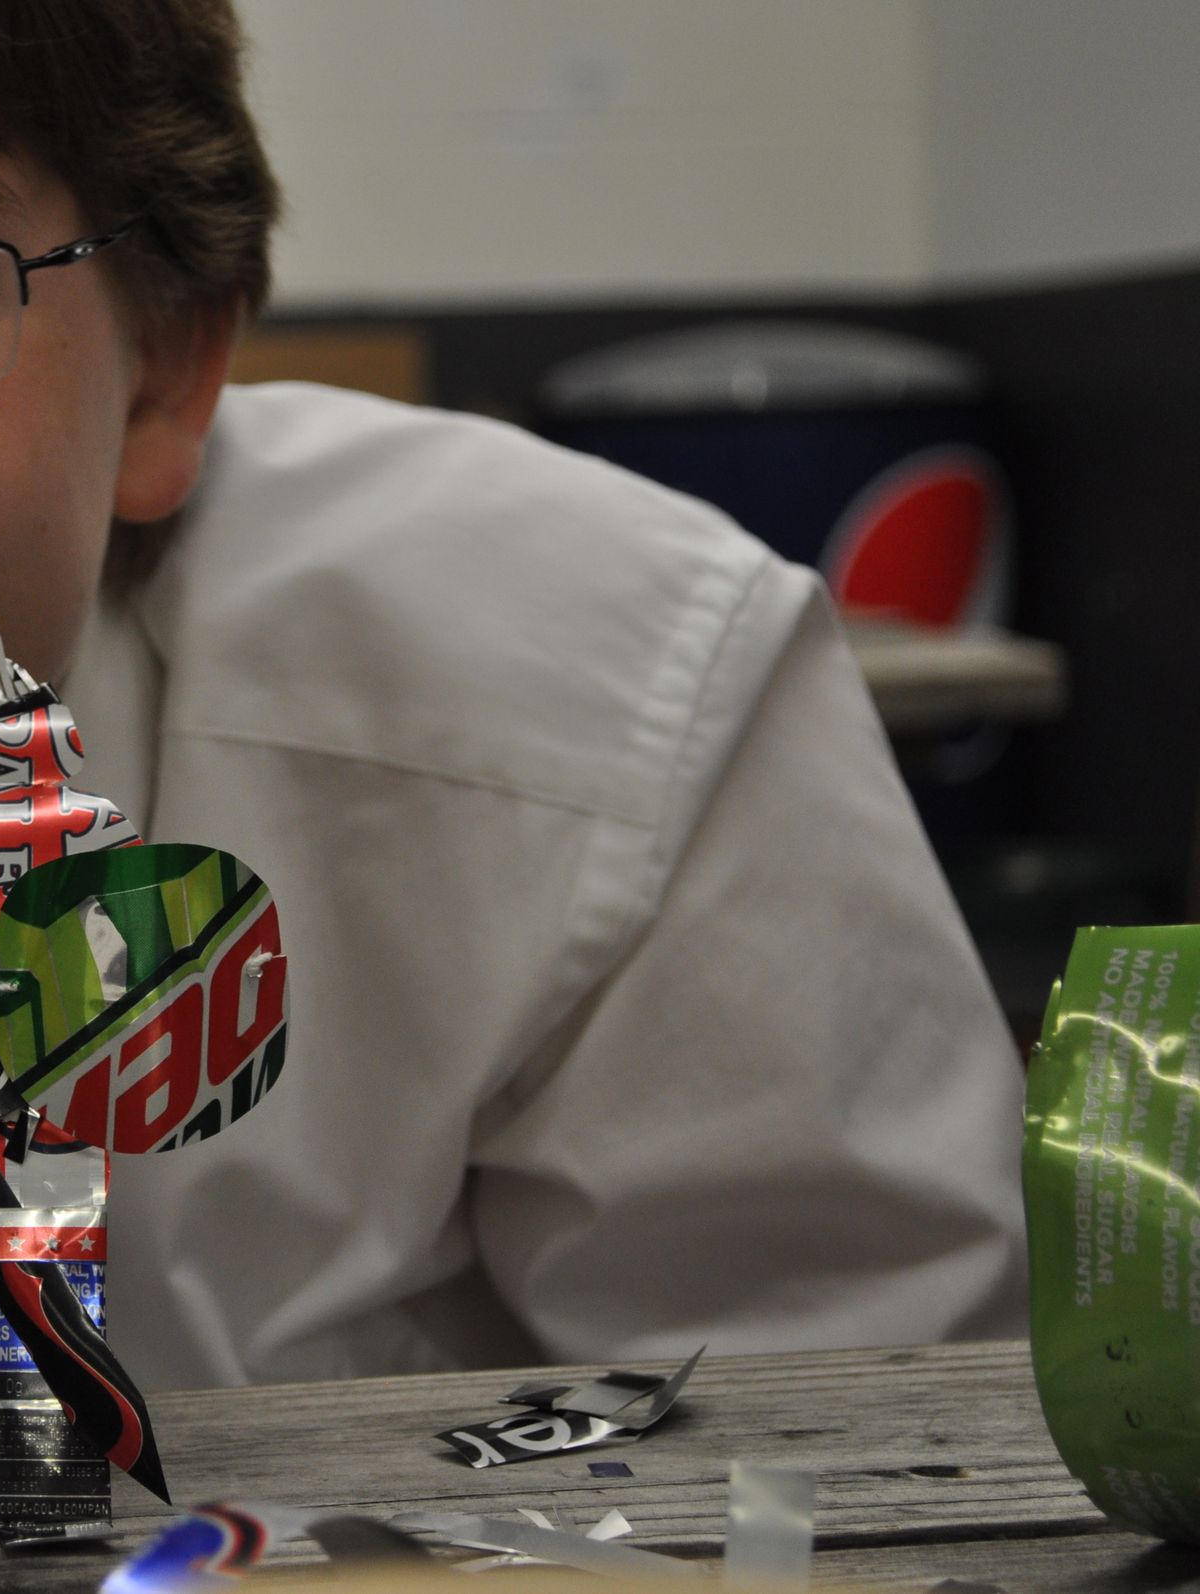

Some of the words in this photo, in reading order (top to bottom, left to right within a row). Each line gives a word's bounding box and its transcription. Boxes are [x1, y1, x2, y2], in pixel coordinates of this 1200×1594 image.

[1104, 948, 1129, 985] NO
[1118, 950, 1153, 1024] MADE
[1149, 951, 1179, 1010] 100%
[1099, 1111, 1123, 1181] REAL
[1075, 1132, 1097, 1307] INGREDIENTS
[1096, 1190, 1116, 1285] SUGAR
[1161, 1207, 1181, 1313] FLAVORS
[63, 1502, 110, 1516] COMPAN
